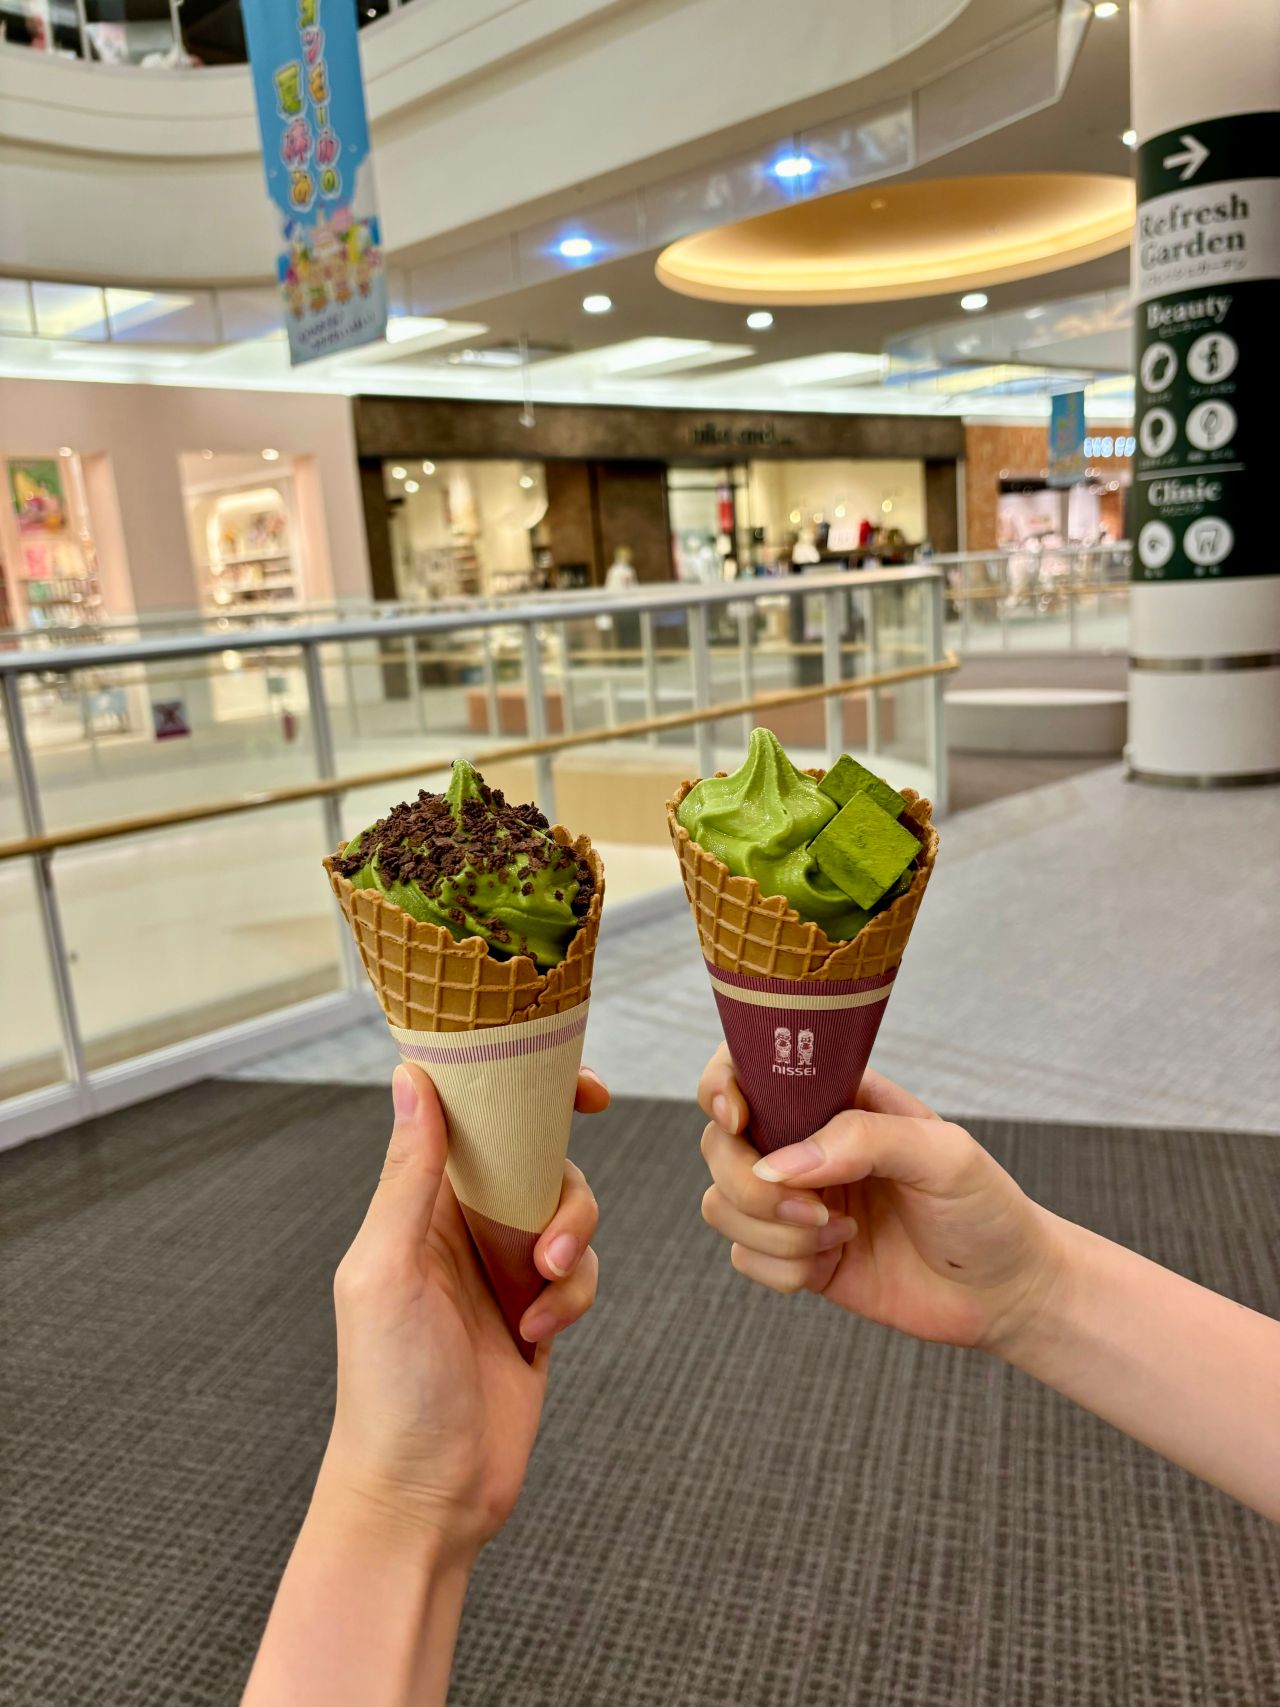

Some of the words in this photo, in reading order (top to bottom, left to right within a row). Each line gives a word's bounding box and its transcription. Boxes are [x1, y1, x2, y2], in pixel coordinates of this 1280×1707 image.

[1141, 193, 1248, 240] Refresh
[1141, 231, 1245, 271] Garden
[1147, 295, 1232, 330] Beauty
[1148, 477, 1221, 506] Clinic
